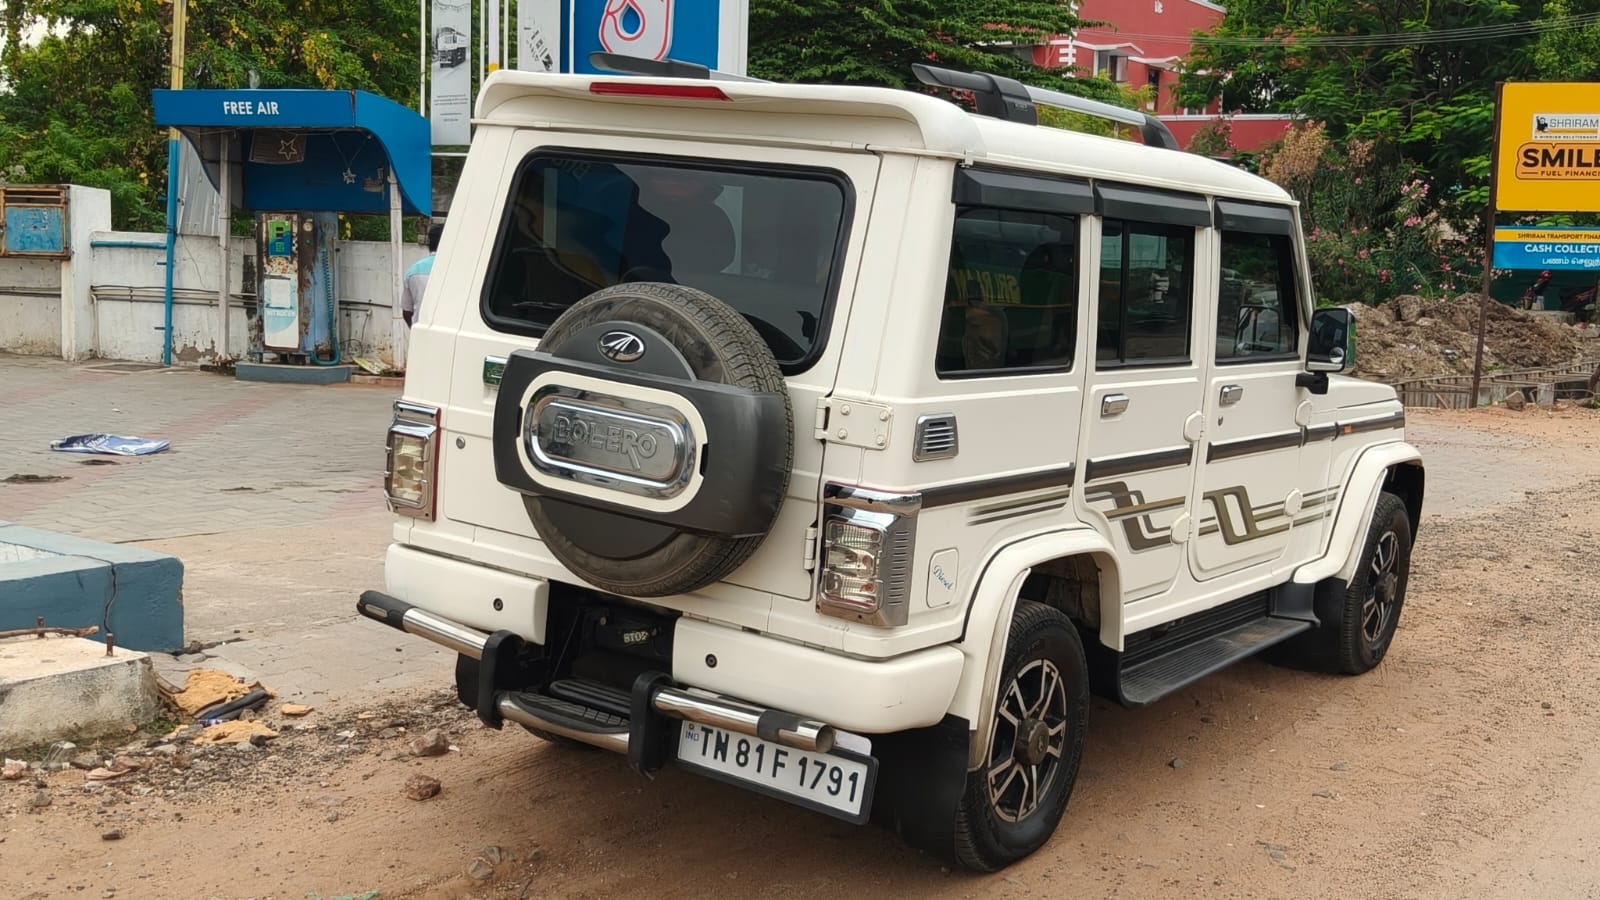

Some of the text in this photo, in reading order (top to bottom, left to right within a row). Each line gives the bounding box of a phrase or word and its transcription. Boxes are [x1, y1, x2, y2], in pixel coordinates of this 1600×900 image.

[223, 101, 280, 115] FREE AIR
[1549, 118, 1599, 128] SHRIRAM
[1547, 232, 1583, 240] TRANSPORT
[1524, 243, 1552, 253] CASH
[553, 413, 658, 472] BOLERO
[685, 731, 700, 742] IND
[700, 726, 859, 803] TN 81 F 1791
